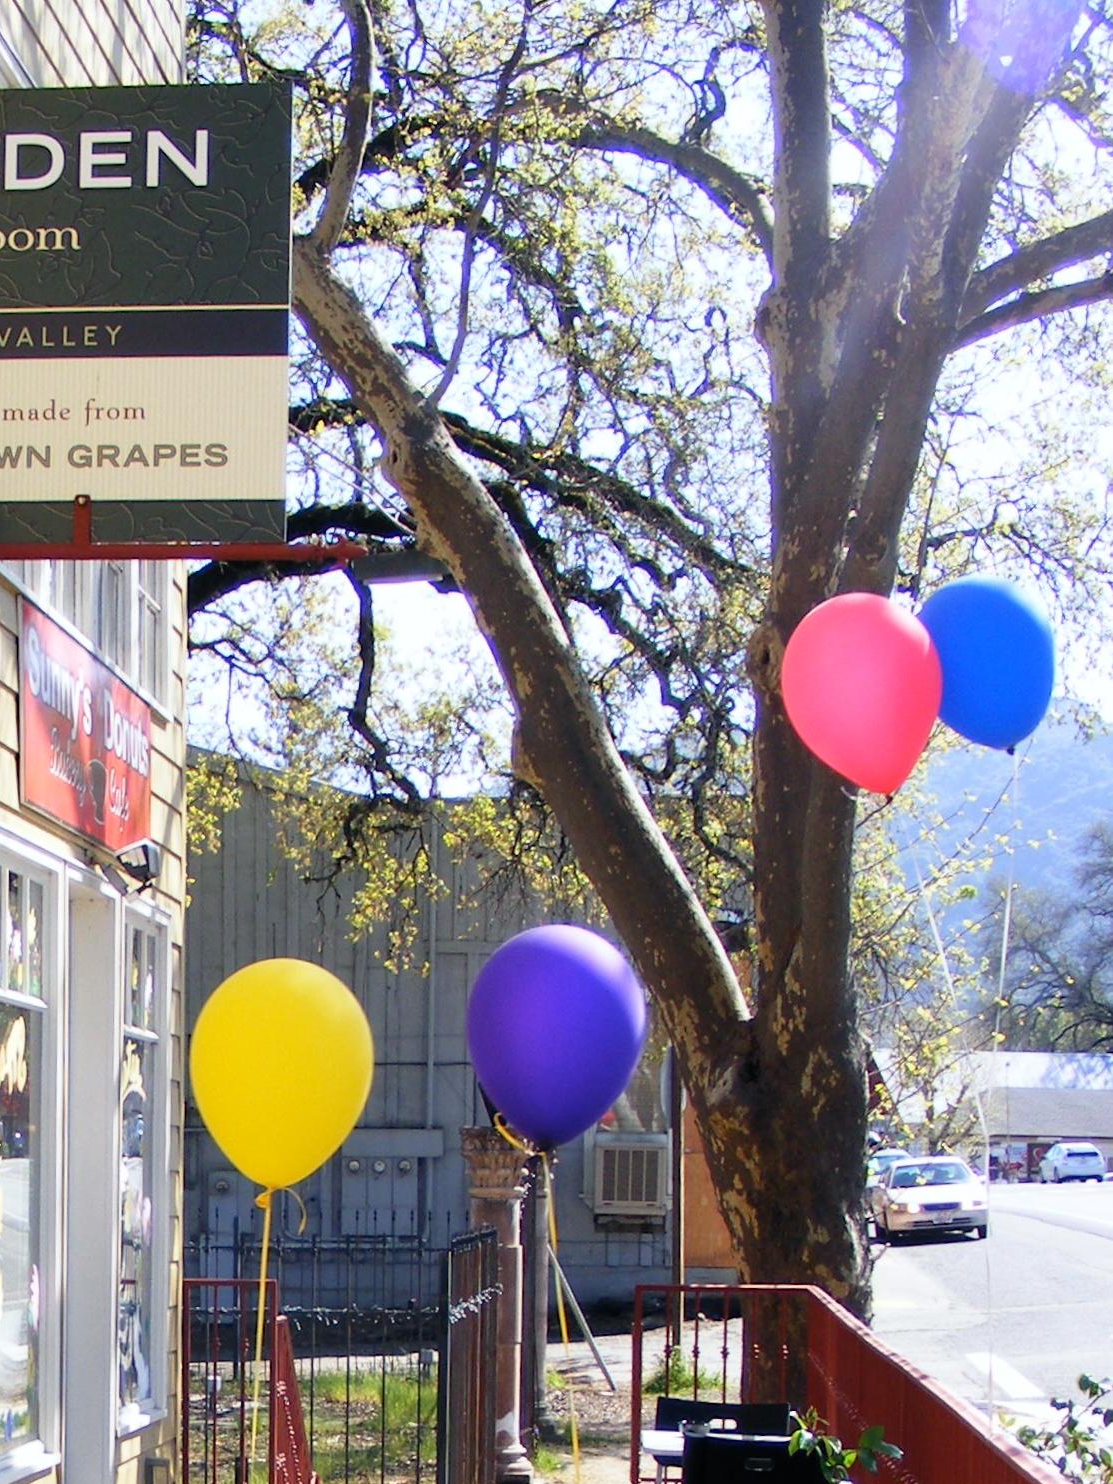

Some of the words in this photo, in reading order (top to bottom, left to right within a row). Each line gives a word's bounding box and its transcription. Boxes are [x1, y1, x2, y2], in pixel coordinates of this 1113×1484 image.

[1, 400, 71, 422] made
[84, 397, 146, 427] from
[66, 443, 229, 469] GRAPES
[27, 626, 93, 741] Sunny's
[103, 687, 150, 778] Donuts
